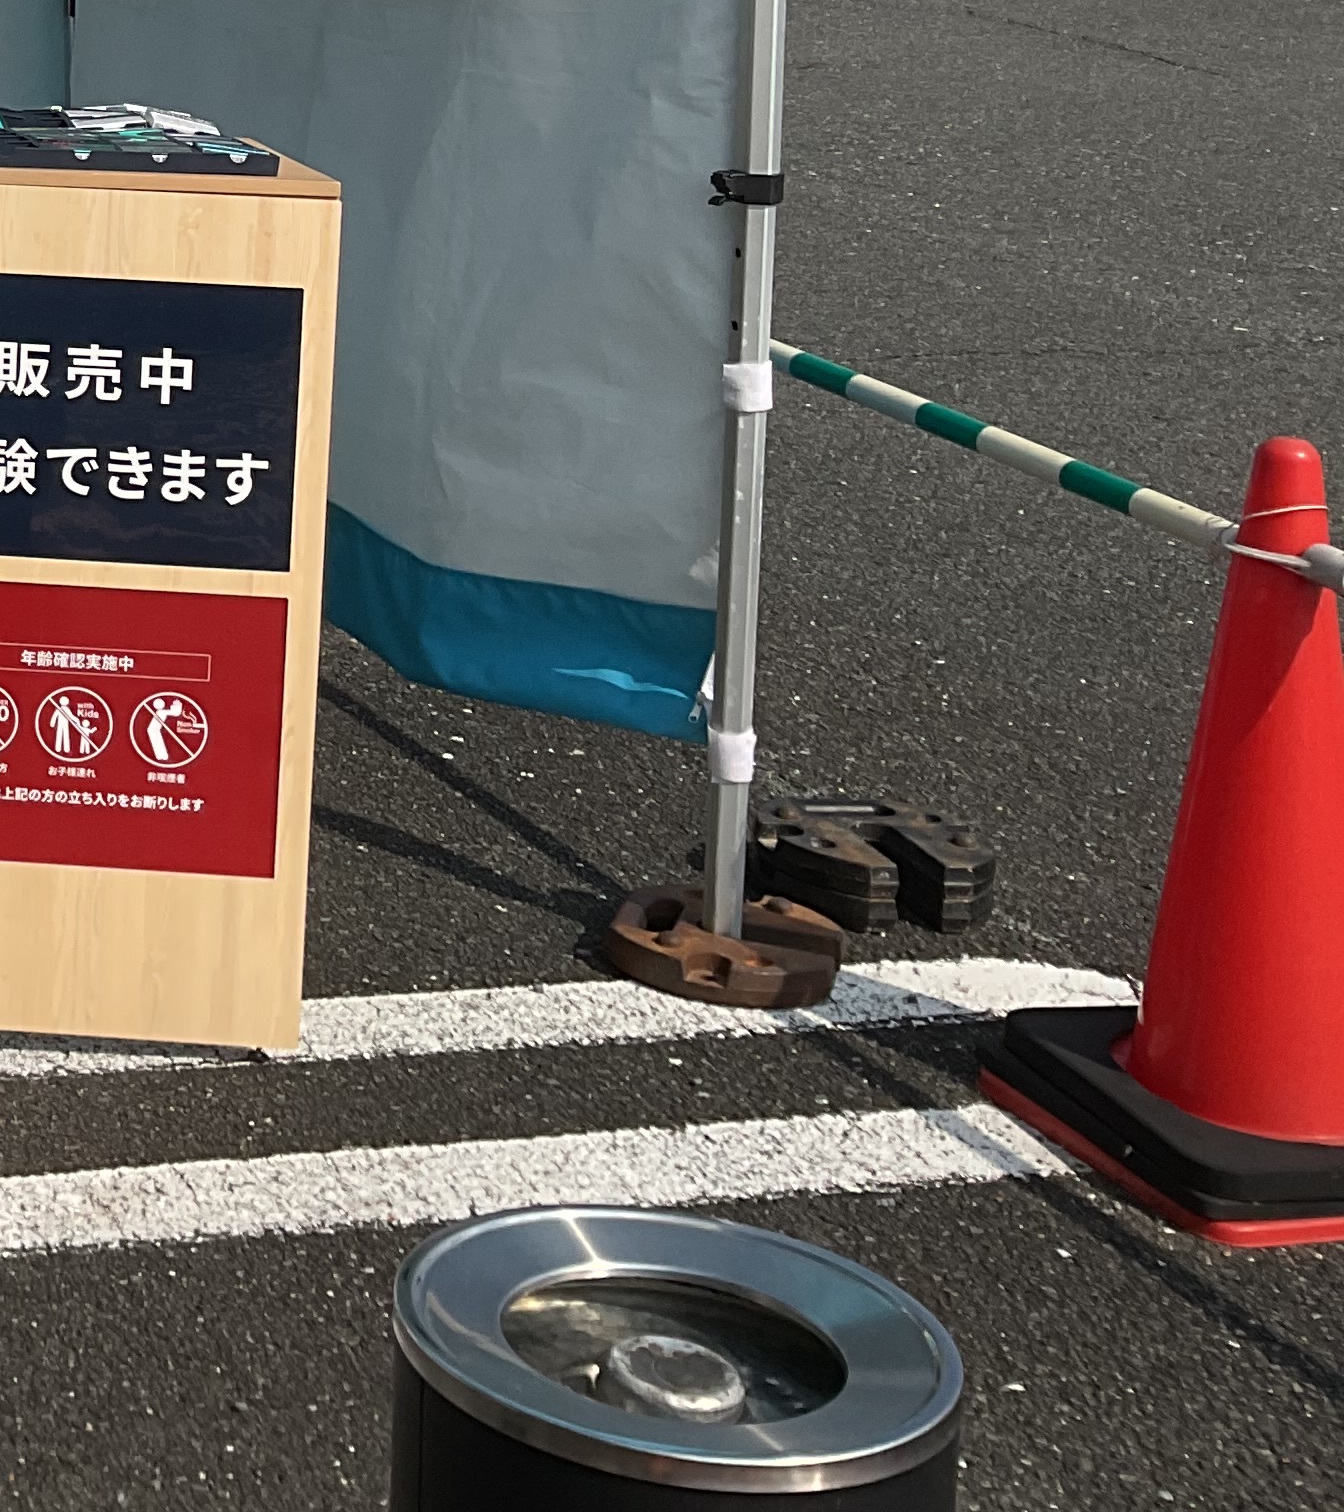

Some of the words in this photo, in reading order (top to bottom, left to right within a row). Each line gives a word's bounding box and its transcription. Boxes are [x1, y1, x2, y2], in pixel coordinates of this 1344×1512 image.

[20, 649, 135, 672] 年齢確認実施中
[77, 709, 99, 719] Kids
[47, 765, 97, 779] お子様連れ
